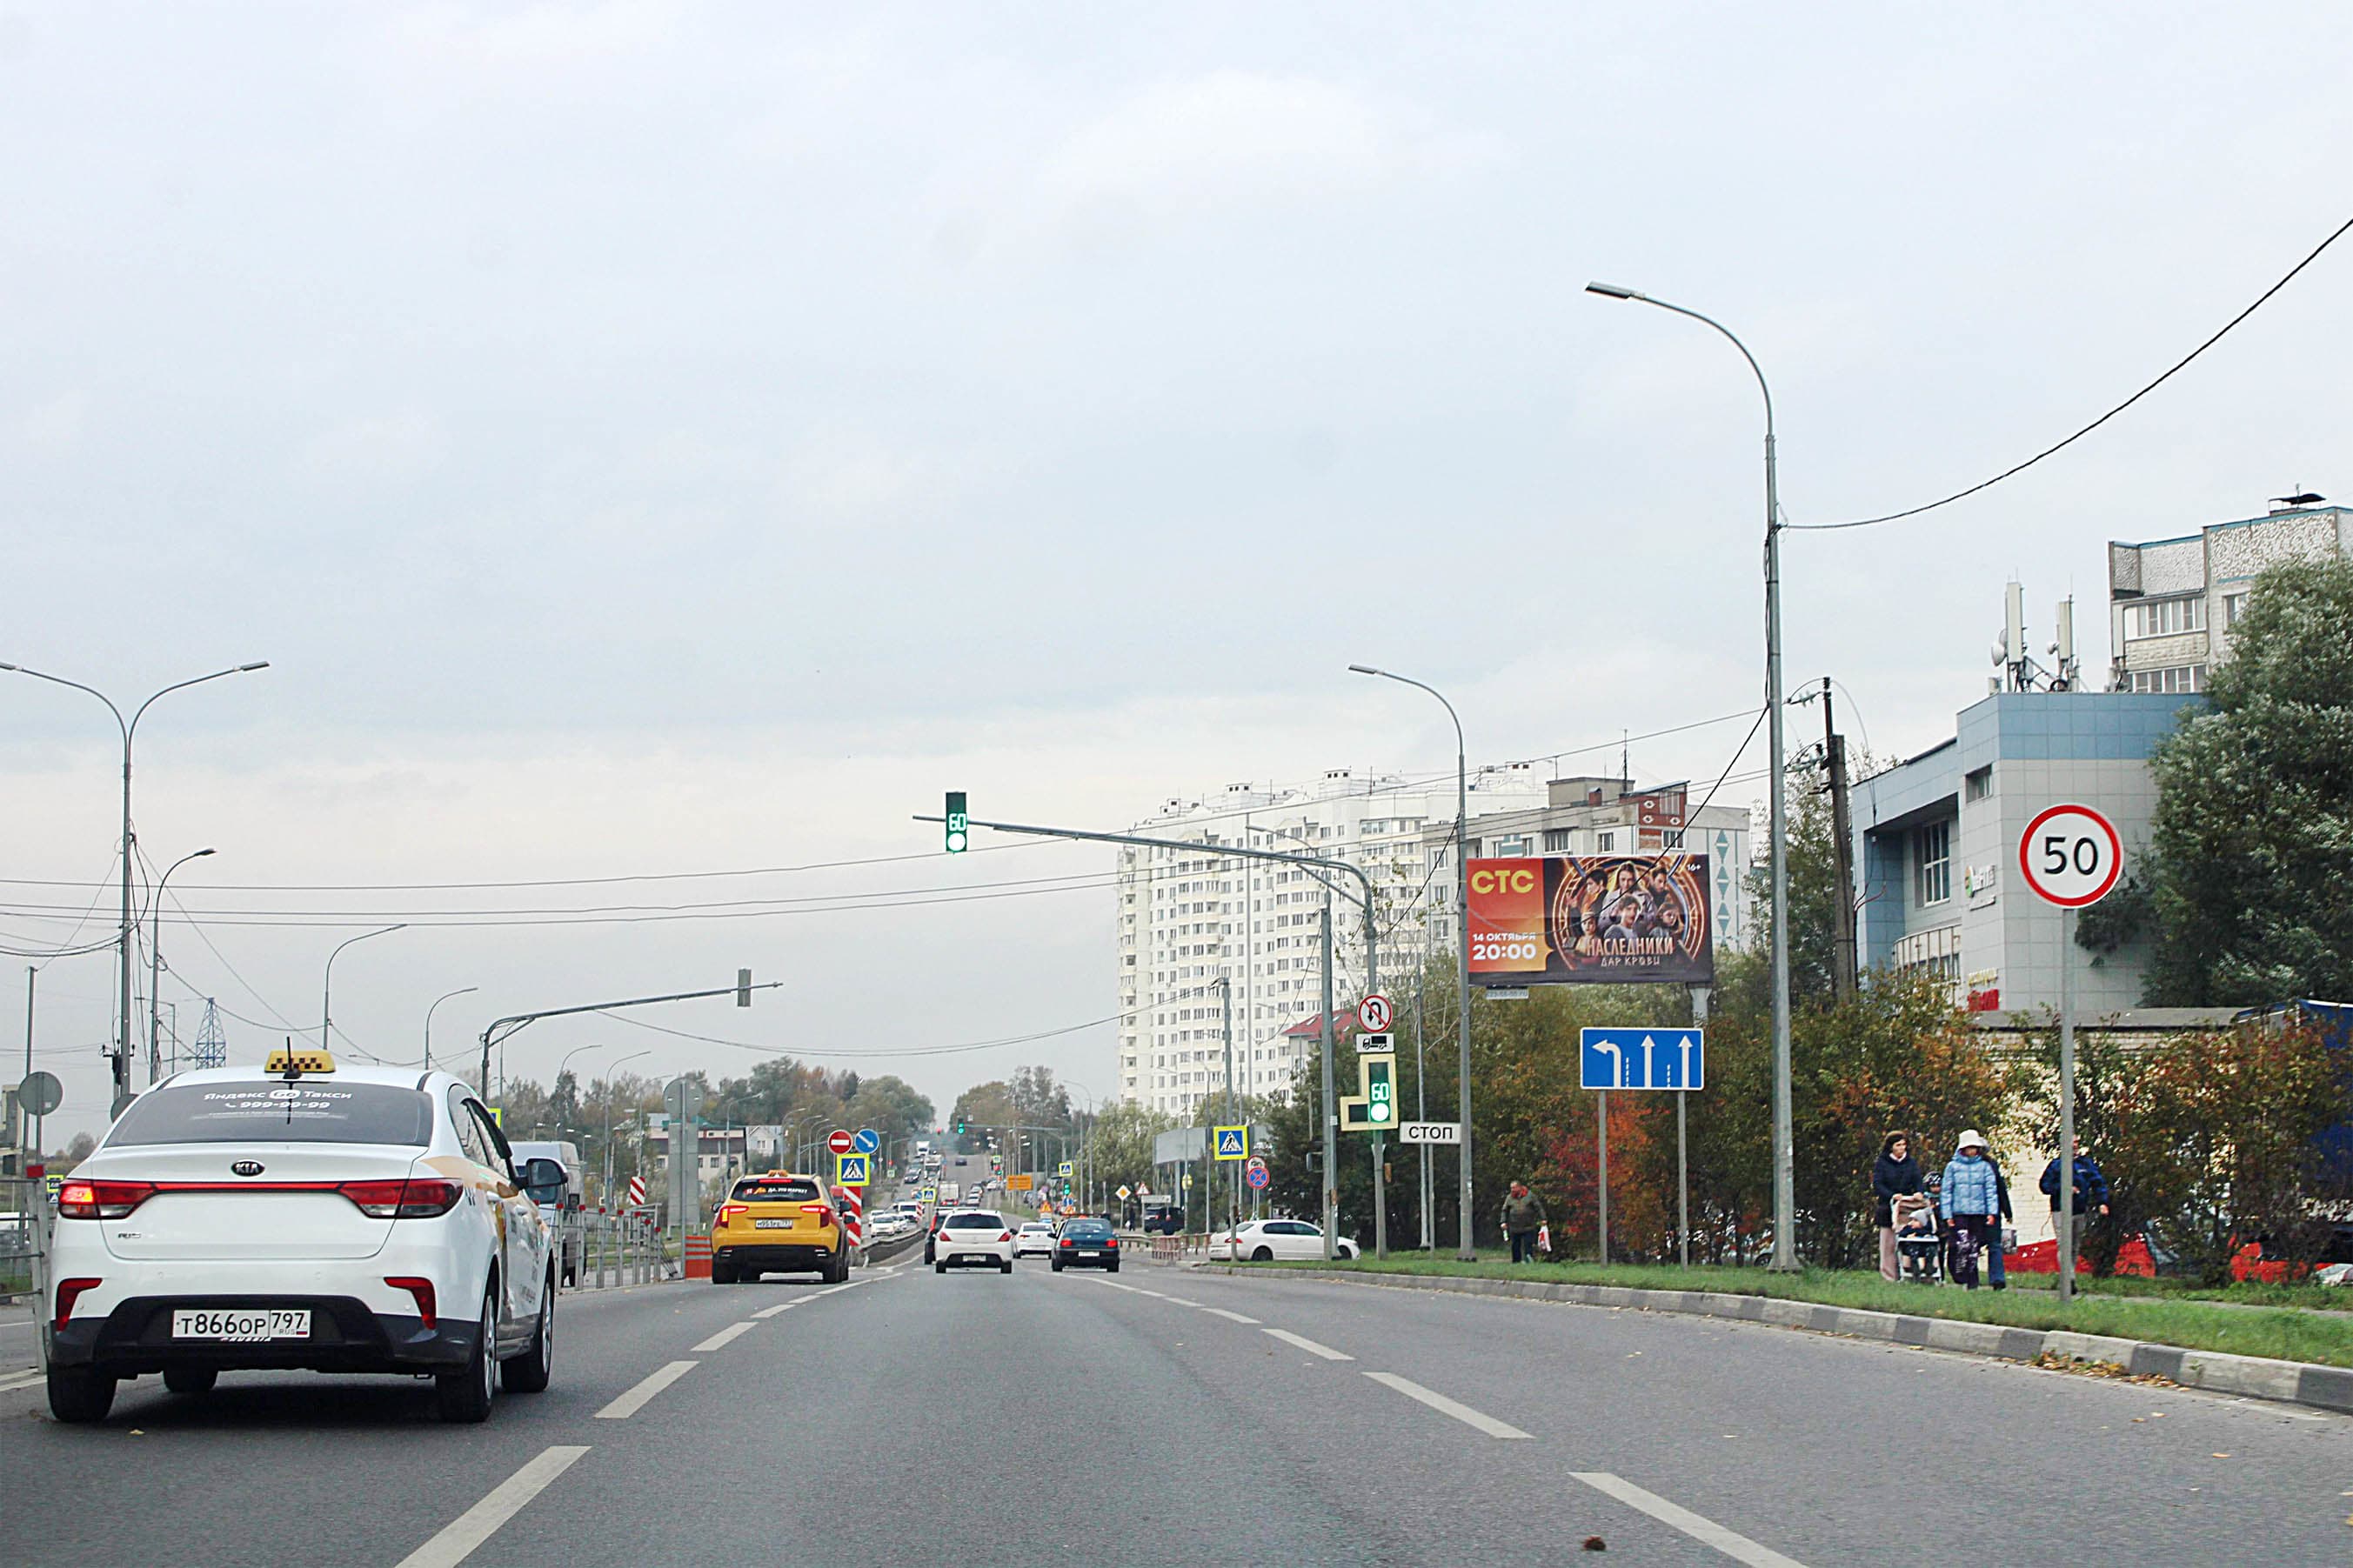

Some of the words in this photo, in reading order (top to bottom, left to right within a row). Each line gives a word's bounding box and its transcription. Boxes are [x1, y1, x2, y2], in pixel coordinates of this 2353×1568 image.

[949, 813, 966, 831] 60
[2044, 837, 2098, 876] 50
[1471, 870, 1534, 895] СТС
[1473, 932, 1484, 942] 14
[1486, 932, 1537, 942] ОКТЯБРЯ
[1473, 944, 1537, 960] 20:00
[1587, 937, 1674, 957] НАСЛЕДНИКИ
[1601, 957, 1621, 967] ДАР
[1624, 956, 1661, 966] КРОВИ
[204, 1091, 265, 1100] Яндекс
[304, 1091, 352, 1099] Такси
[1371, 1083, 1389, 1101] 60
[1409, 1126, 1453, 1139] СТОП
[236, 1163, 259, 1174] KIA
[181, 1313, 266, 1335] Т866ОР
[271, 1312, 305, 1329] 797
